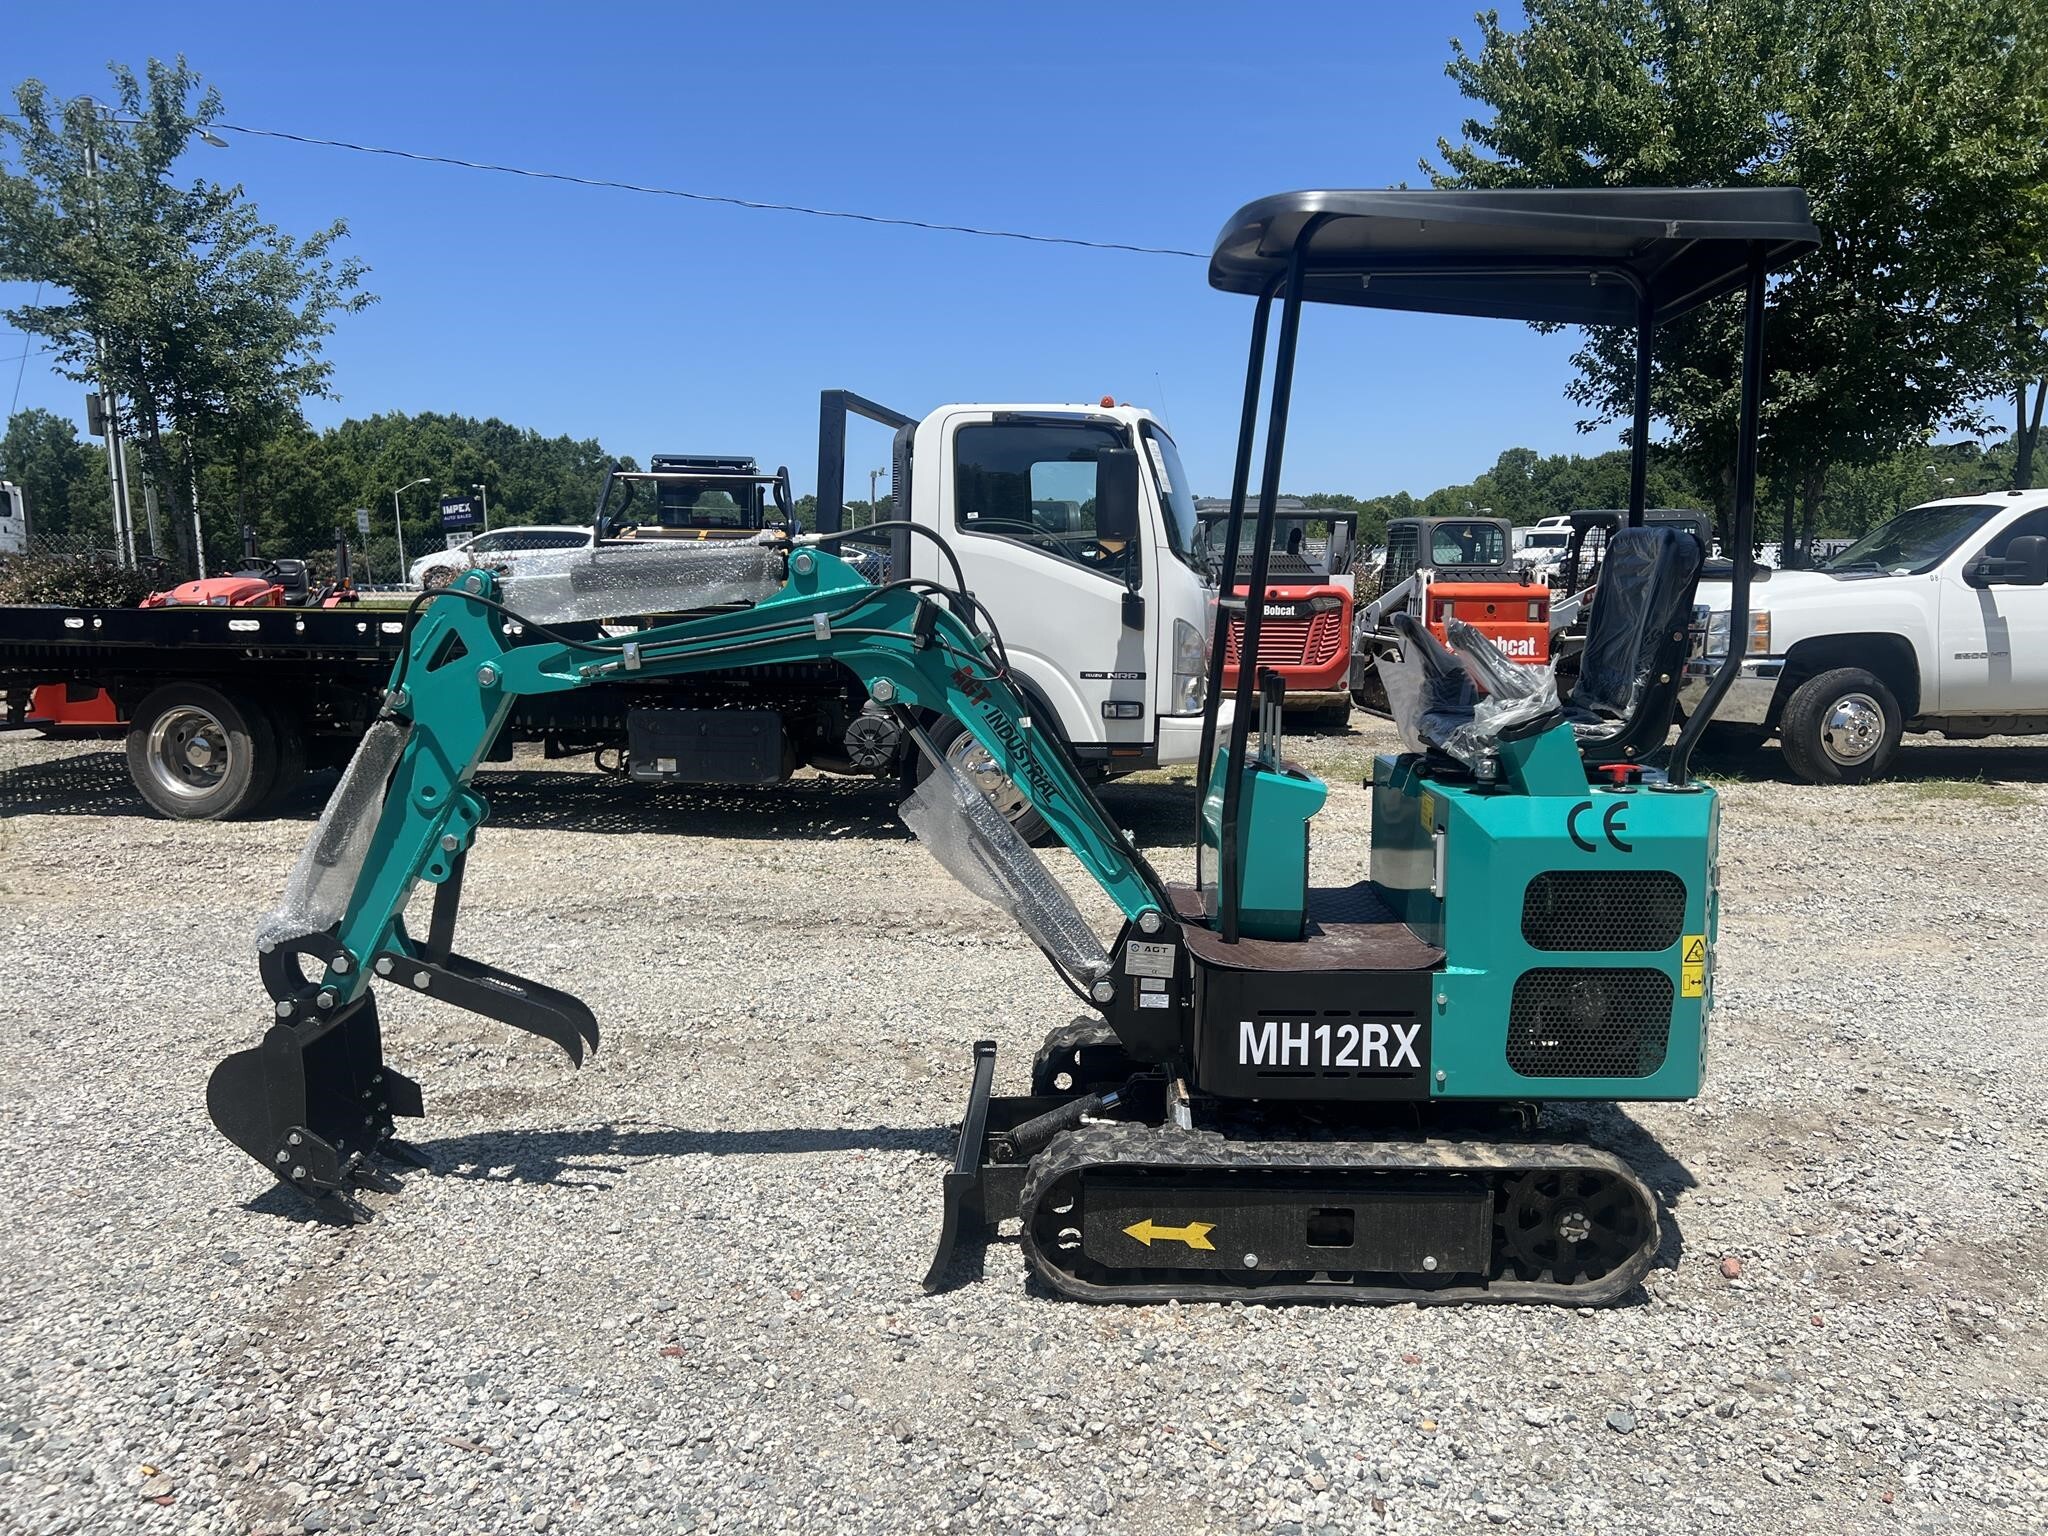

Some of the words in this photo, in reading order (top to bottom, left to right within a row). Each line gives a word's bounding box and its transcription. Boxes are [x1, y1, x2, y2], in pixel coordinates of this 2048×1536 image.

[443, 503, 471, 514] IMPEX
[1263, 605, 1295, 616] Bobcat
[952, 665, 992, 706] AGT
[985, 707, 1057, 804] INDUSTRIAL
[1567, 801, 1632, 852] CE
[1144, 945, 1169, 954] AGT
[1239, 1021, 1422, 1068] MH12RX
